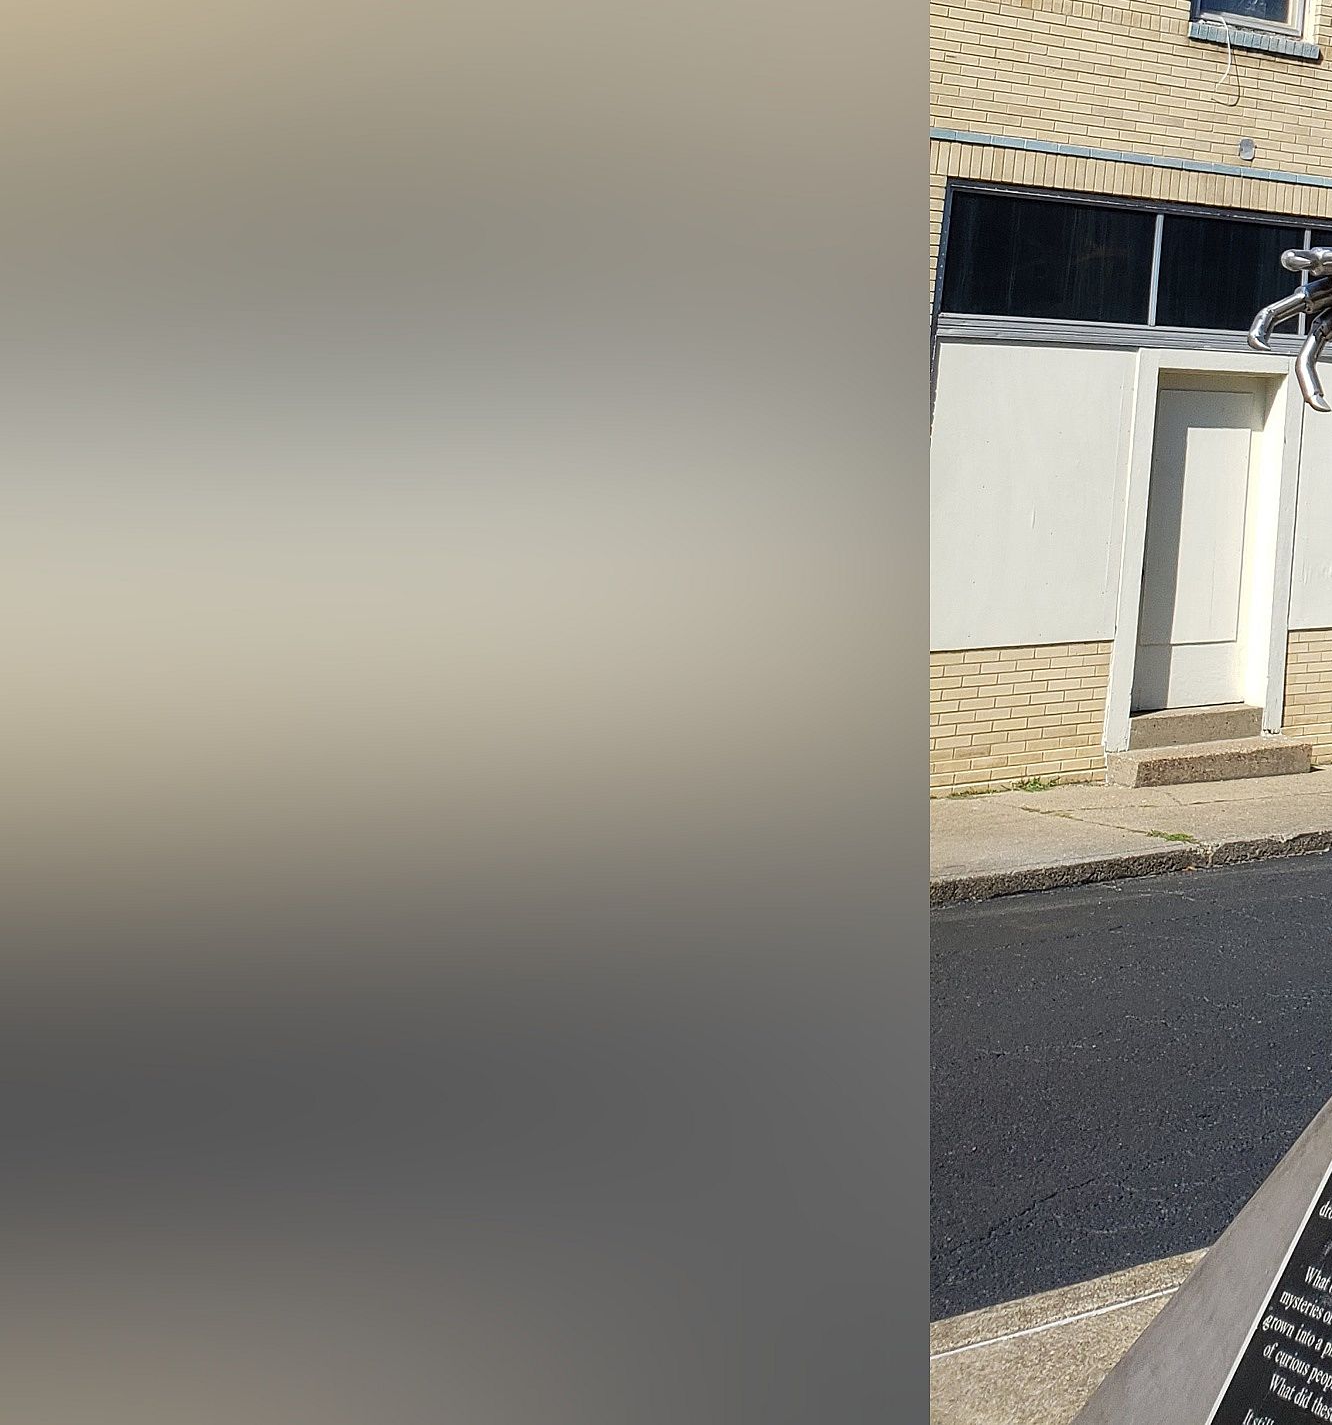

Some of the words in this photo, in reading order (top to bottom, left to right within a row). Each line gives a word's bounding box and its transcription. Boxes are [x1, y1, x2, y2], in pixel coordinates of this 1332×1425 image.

[1304, 1266, 1331, 1291] What
[1280, 1291, 1324, 1320] mysteries
[1262, 1315, 1295, 1338] grown
[1294, 1324, 1316, 1346] into
[1314, 1338, 1324, 1351] a
[1263, 1342, 1279, 1358] of
[1275, 1352, 1311, 1376] curious
[1269, 1373, 1296, 1400] What
[1294, 1387, 1314, 1409] did
[1242, 1409, 1255, 1425] It
